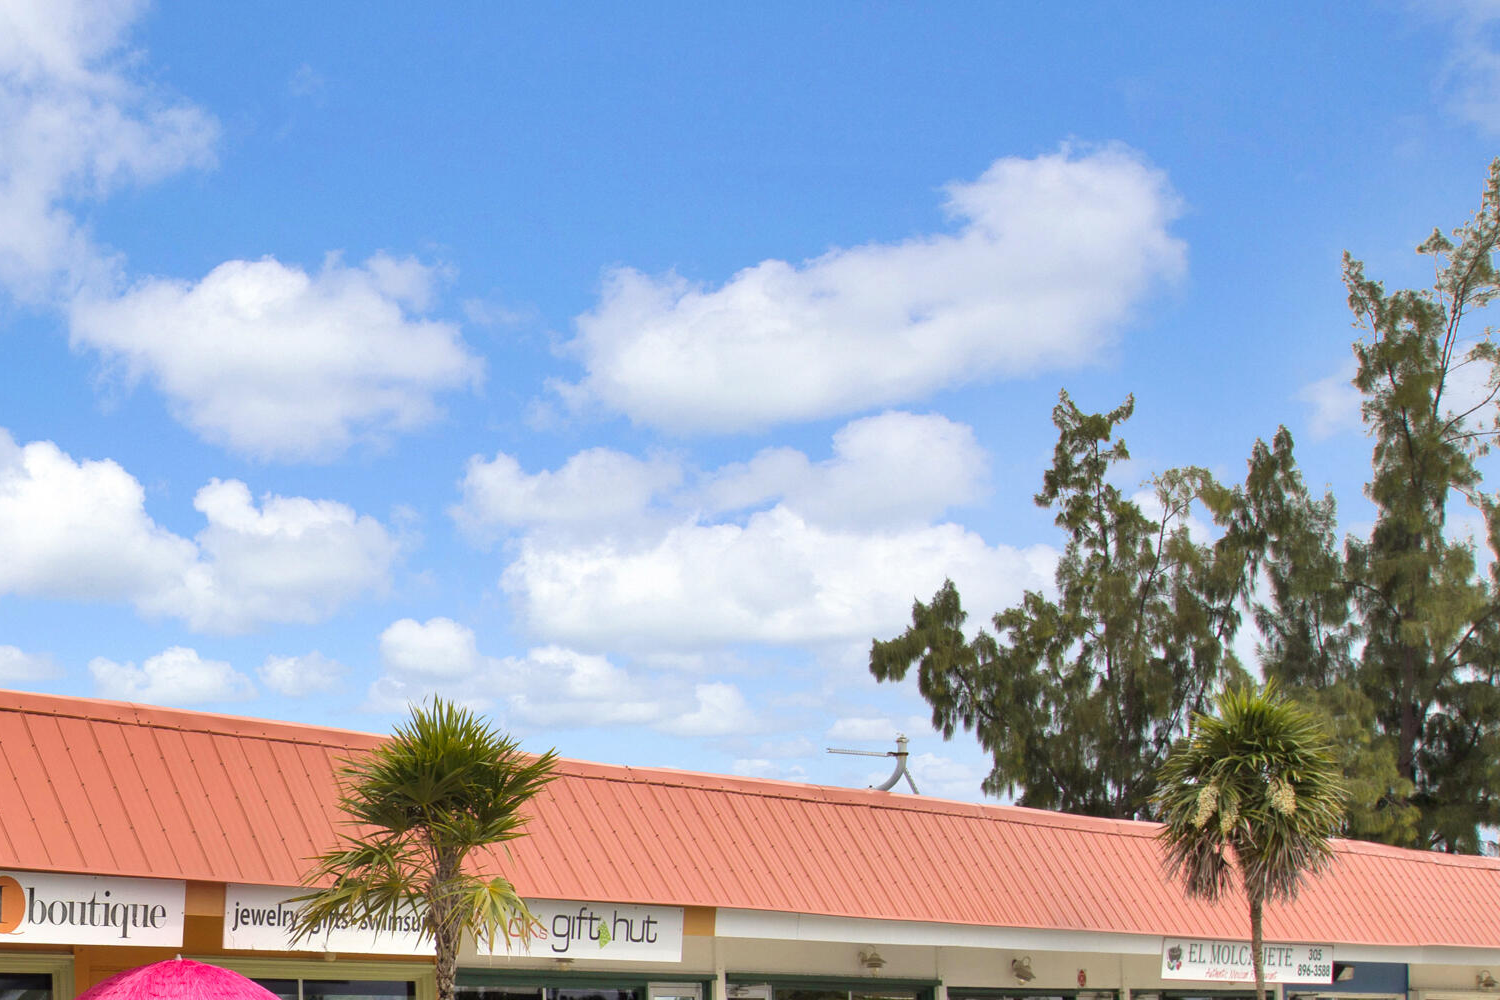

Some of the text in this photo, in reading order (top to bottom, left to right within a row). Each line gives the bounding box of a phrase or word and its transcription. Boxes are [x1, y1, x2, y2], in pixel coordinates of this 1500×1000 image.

[26, 887, 168, 939] boutique
[232, 901, 299, 933] jewelry
[551, 907, 602, 953] gift
[612, 910, 659, 943] hut
[1188, 943, 1206, 964] EL
[1308, 948, 1323, 962] 305
[1297, 964, 1331, 978] 896-3588
